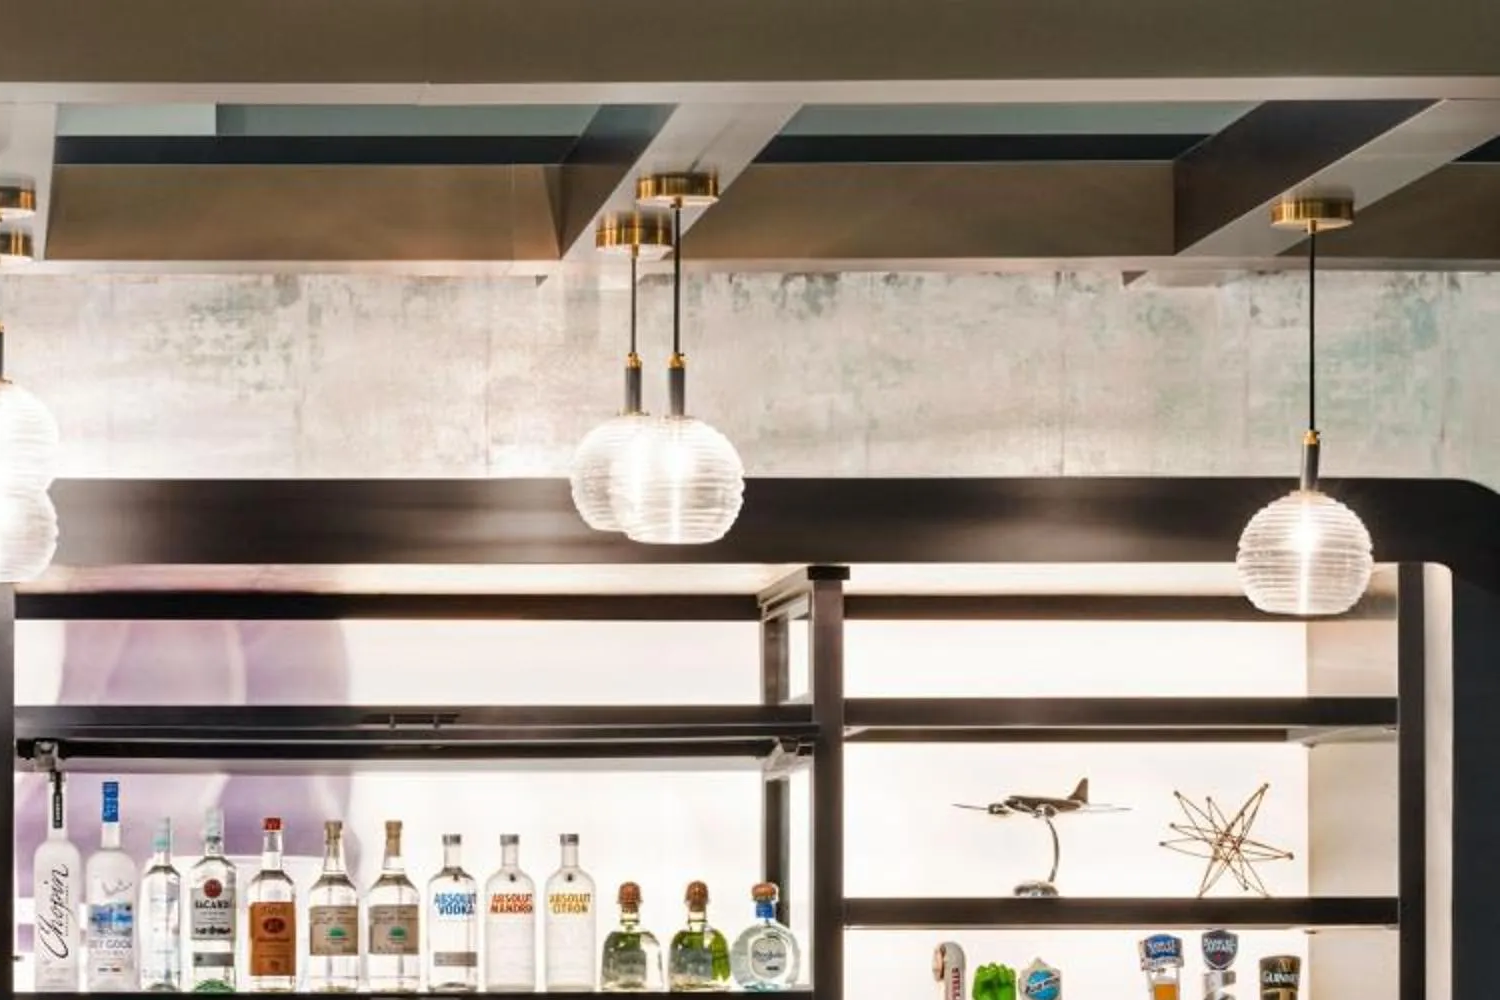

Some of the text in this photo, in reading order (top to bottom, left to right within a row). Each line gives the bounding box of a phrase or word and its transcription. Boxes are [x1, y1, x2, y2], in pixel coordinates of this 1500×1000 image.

[434, 892, 476, 904] ABSOLUT
[492, 892, 533, 903] ABSOLUT
[549, 893, 591, 904] ABSOLUT
[39, 863, 69, 959] Chopin
[438, 903, 475, 915] VODKA
[552, 903, 588, 914] CITRON
